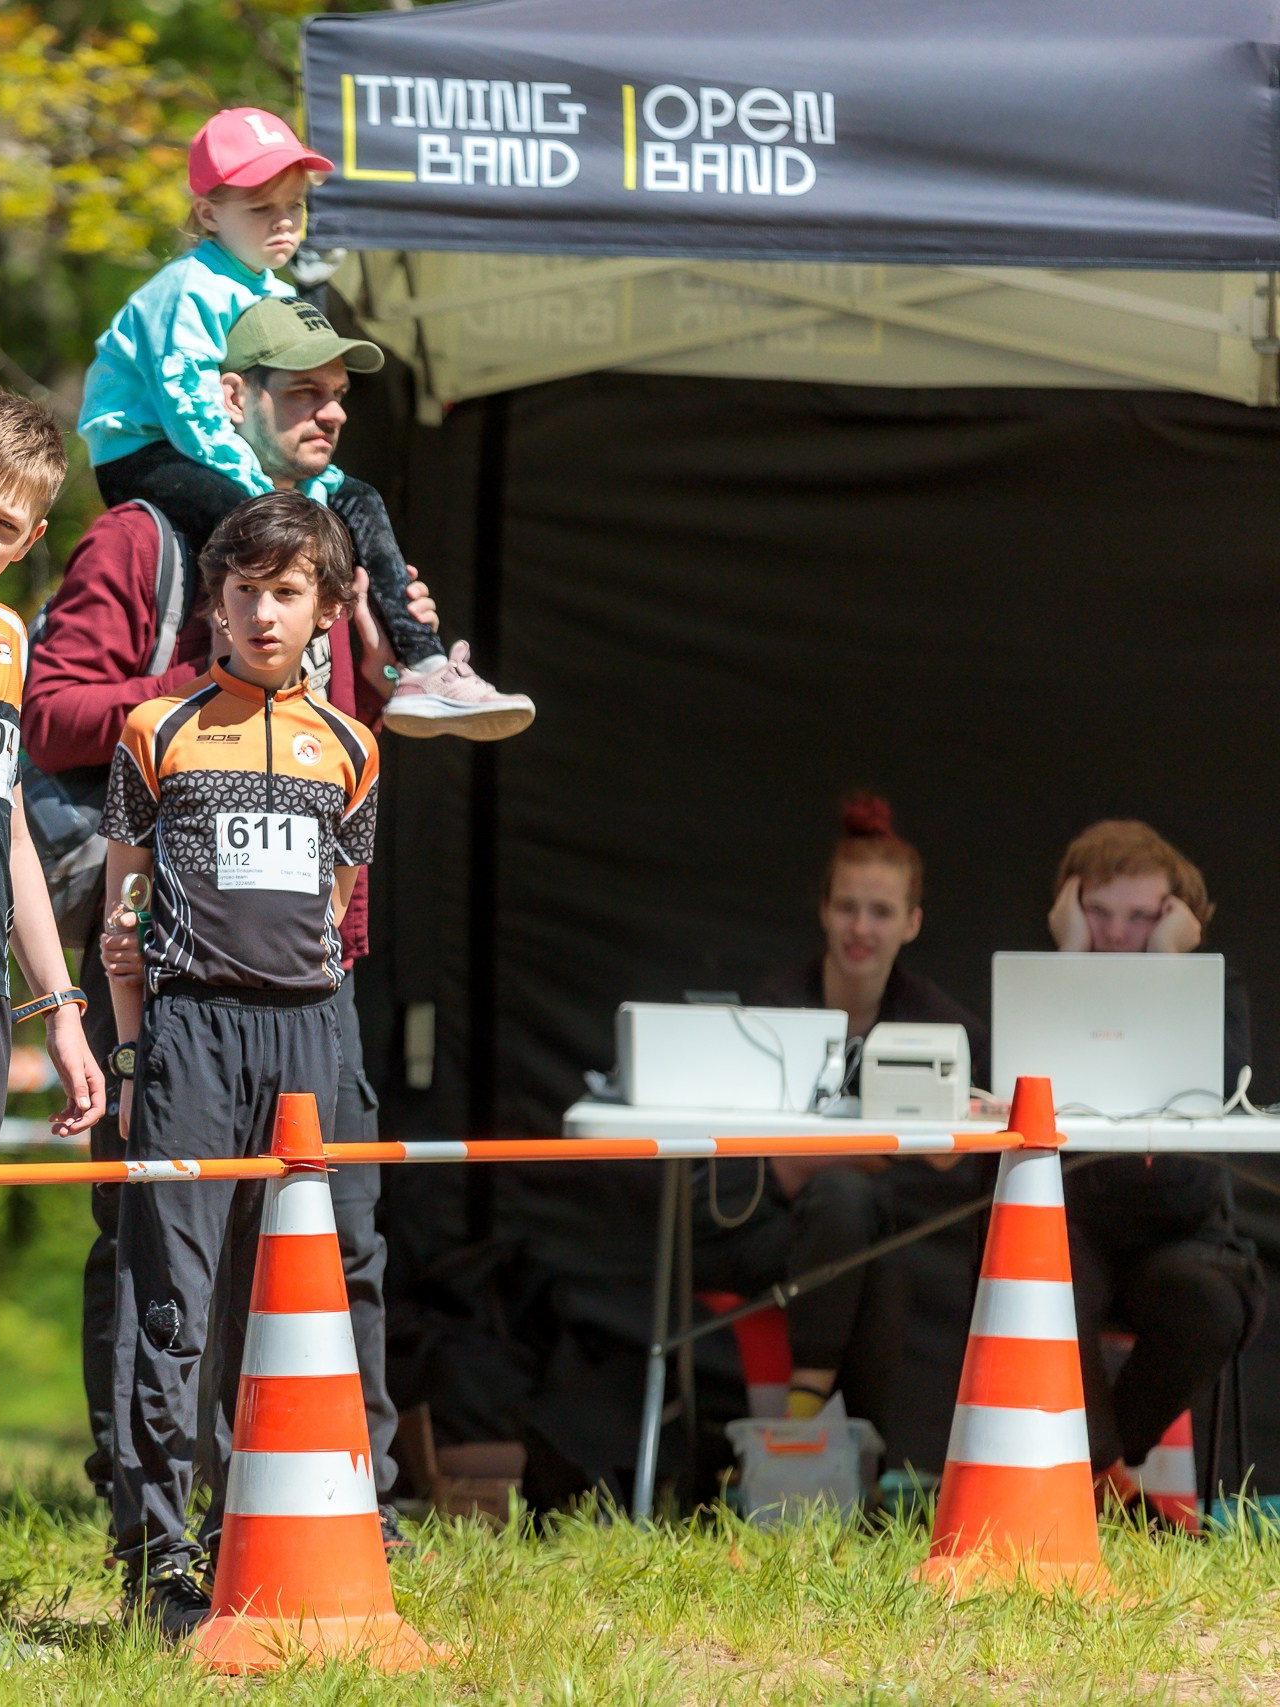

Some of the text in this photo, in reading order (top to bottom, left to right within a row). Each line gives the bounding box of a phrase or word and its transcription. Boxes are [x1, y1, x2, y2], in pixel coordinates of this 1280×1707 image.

[355, 74, 587, 135] TIMING
[243, 114, 285, 146] L
[417, 132, 581, 188] BAND
[644, 141, 817, 196] BAND
[227, 816, 293, 851] 611
[307, 838, 317, 859] 3
[218, 853, 251, 866] M12
